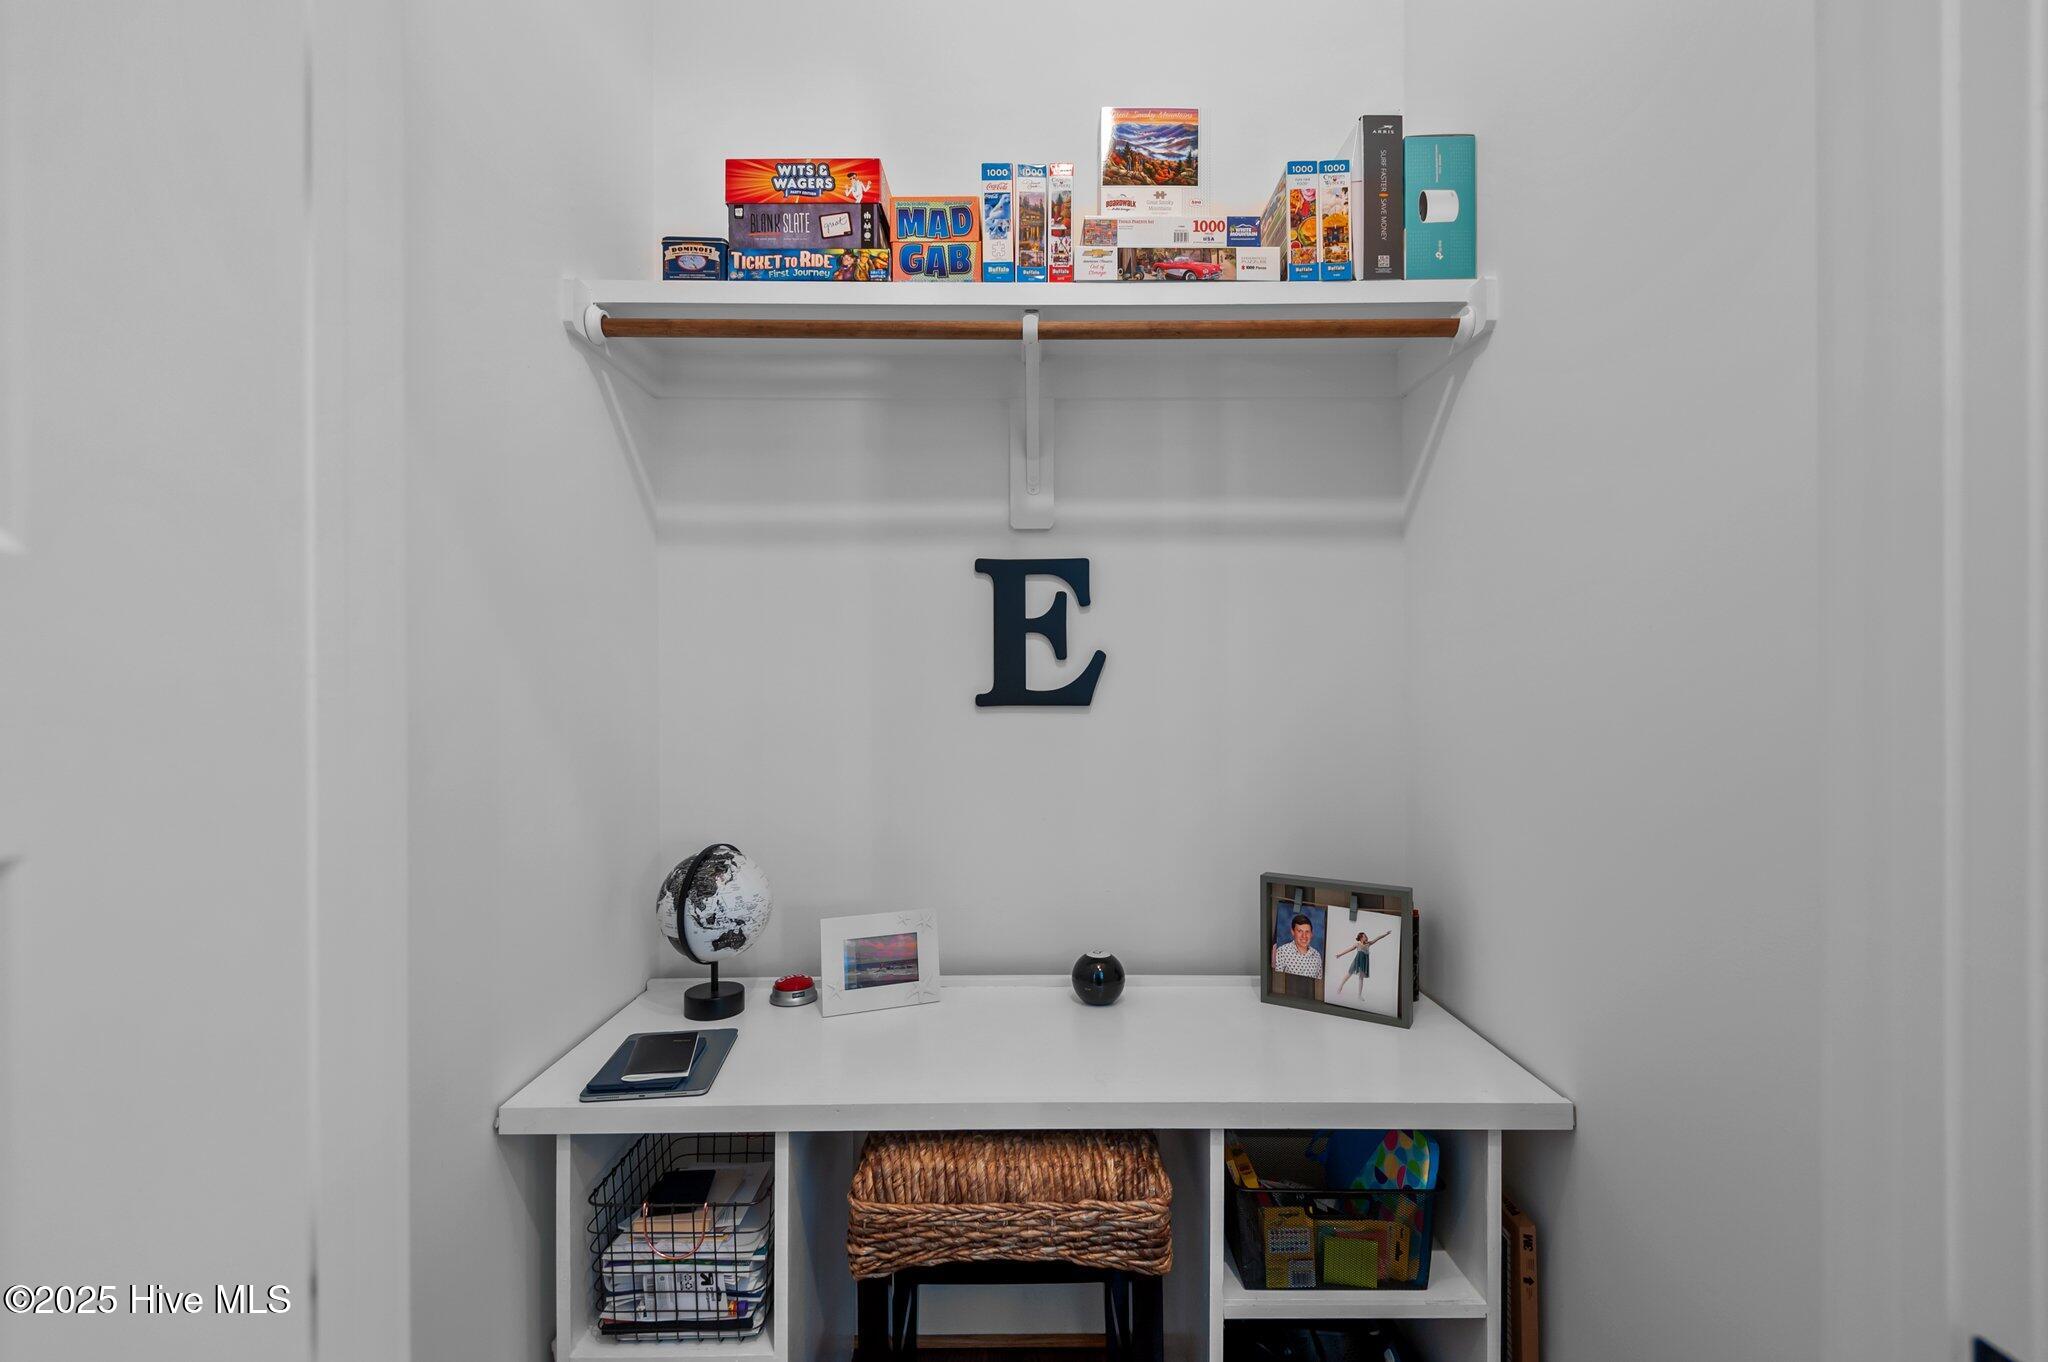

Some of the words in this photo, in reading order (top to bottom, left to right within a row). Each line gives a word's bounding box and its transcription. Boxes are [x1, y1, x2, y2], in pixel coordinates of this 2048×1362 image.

[777, 164, 814, 176] WITS
[819, 164, 828, 176] &
[986, 168, 1009, 177] 1000
[1021, 168, 1044, 177] 1000
[1292, 165, 1314, 173] 1000
[1323, 164, 1346, 172] 1000
[773, 177, 833, 189] WAGERS
[750, 212, 781, 233] BLANK
[782, 212, 811, 234] SLATE
[896, 206, 973, 240] MAD
[1192, 219, 1226, 233] 1000
[671, 246, 713, 254] DOMINOES
[730, 251, 783, 269] TICKET
[784, 256, 798, 267] TO
[800, 250, 835, 269] RIDE
[899, 242, 972, 279] GAB
[768, 269, 790, 279] First
[792, 269, 831, 279] Journey
[988, 266, 1010, 274] Buffalo
[975, 558, 1106, 706] E
